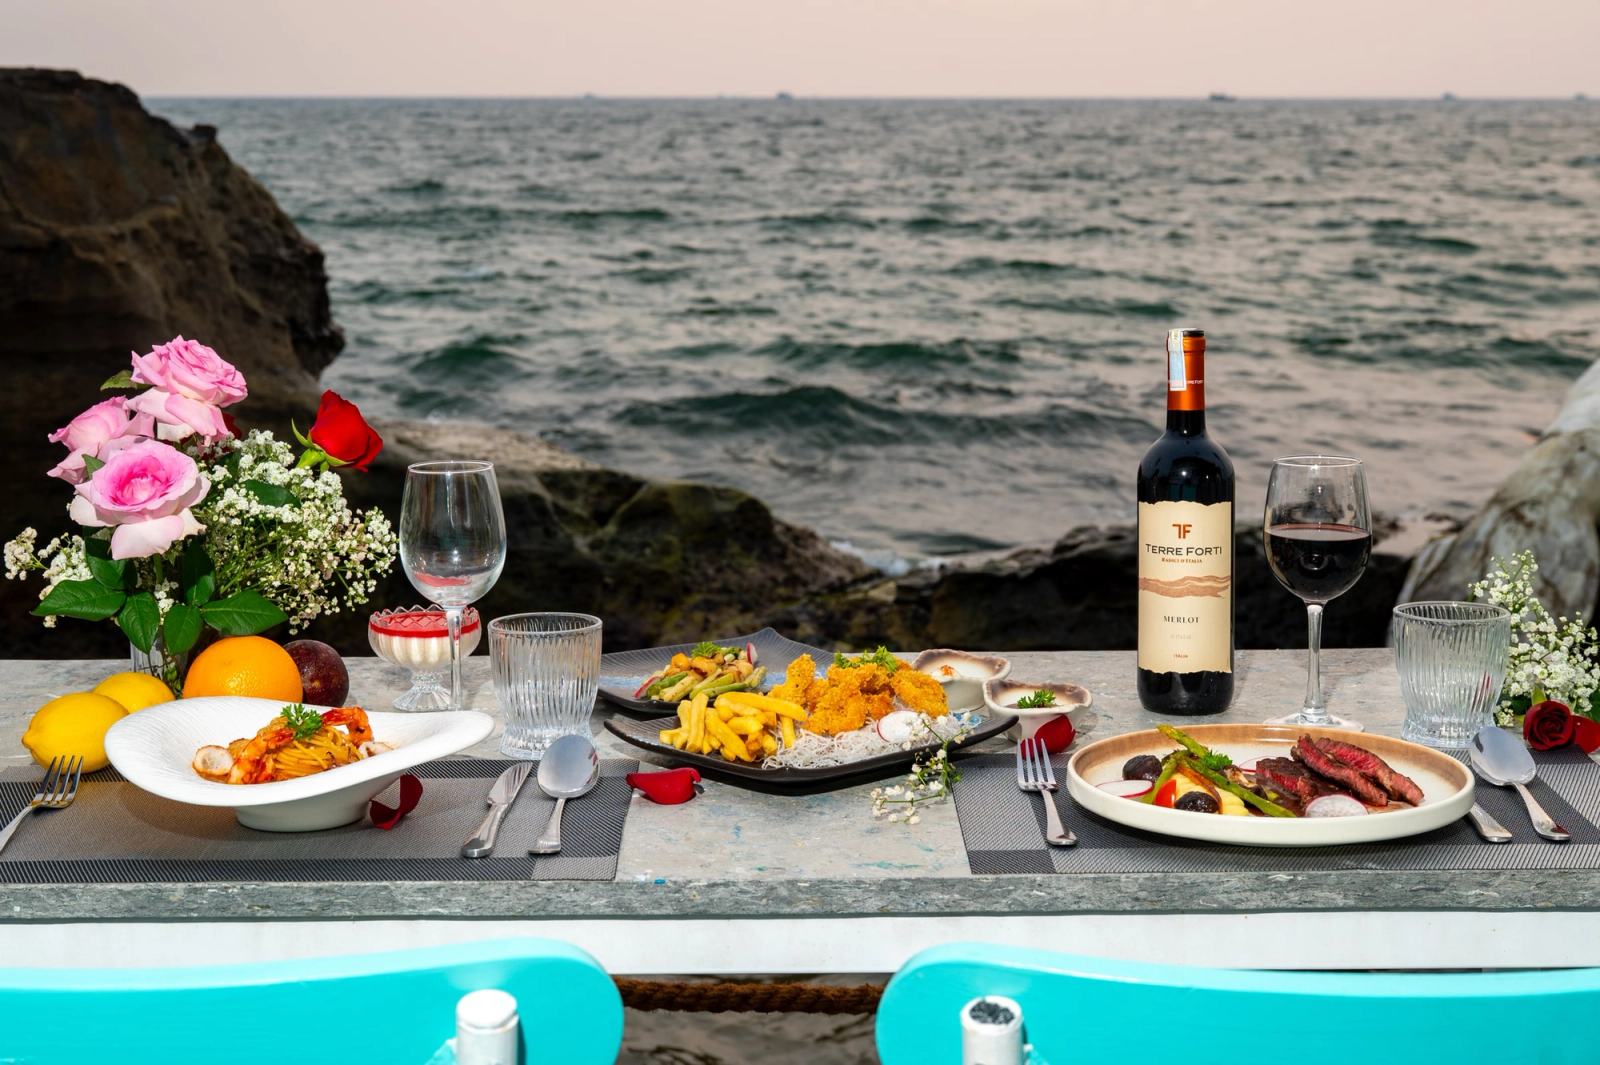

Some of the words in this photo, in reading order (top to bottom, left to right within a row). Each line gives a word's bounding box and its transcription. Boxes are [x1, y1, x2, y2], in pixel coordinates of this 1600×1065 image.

[1145, 543, 1183, 556] TERRE
[1186, 546, 1222, 556] FORTI
[1163, 615, 1199, 624] MERLOT
